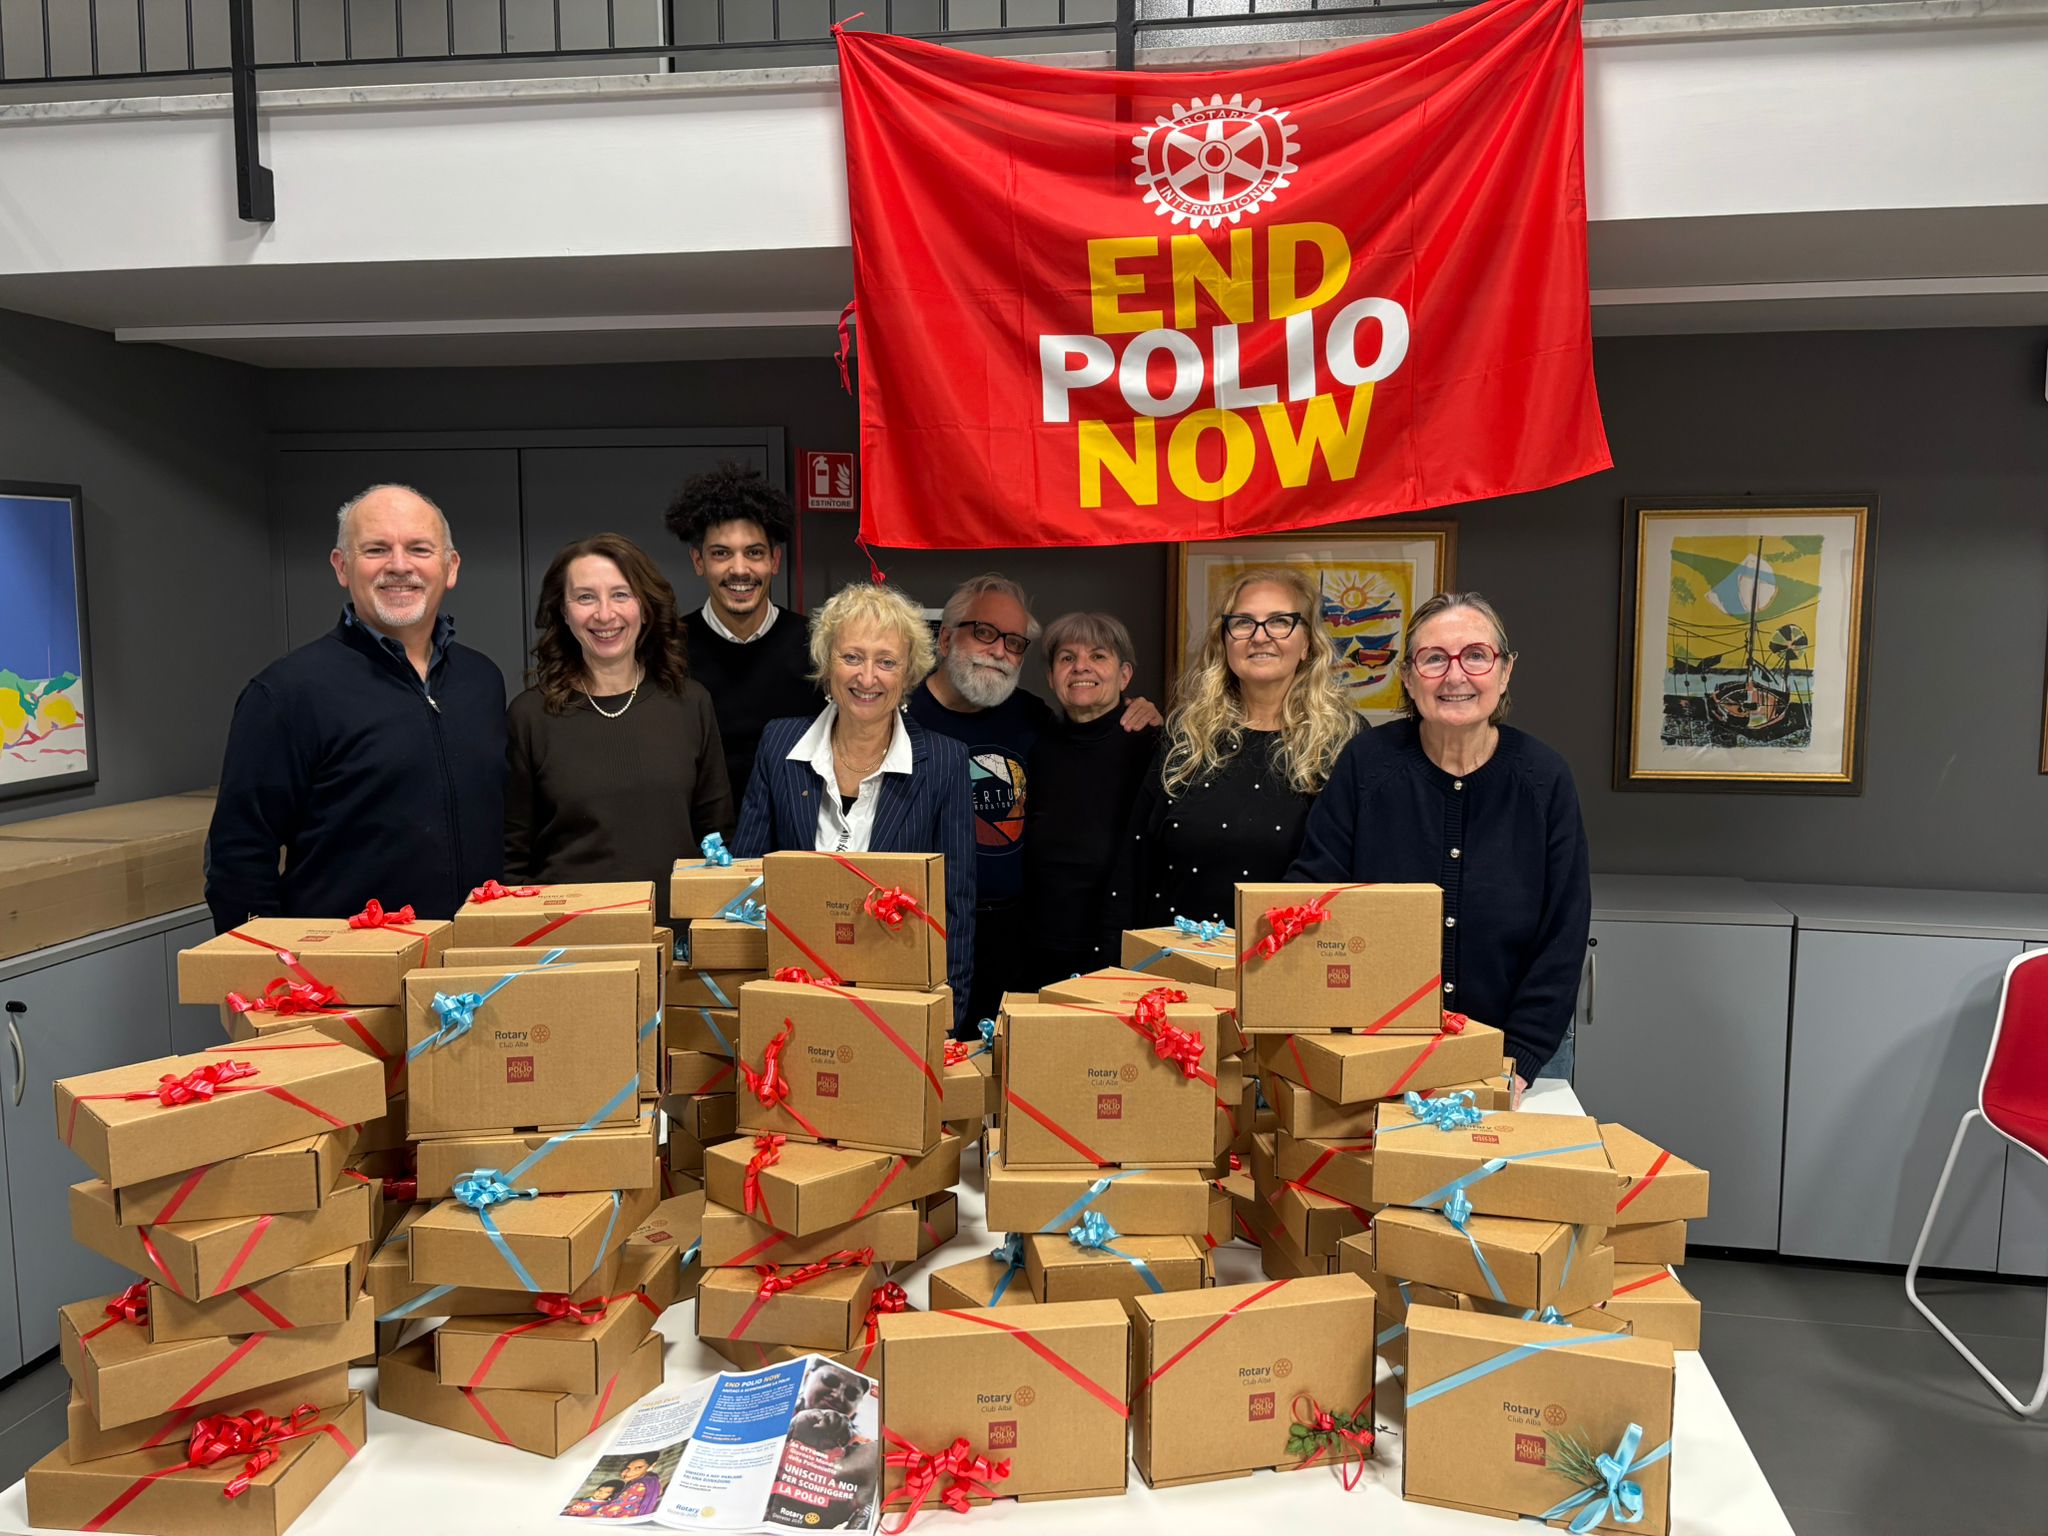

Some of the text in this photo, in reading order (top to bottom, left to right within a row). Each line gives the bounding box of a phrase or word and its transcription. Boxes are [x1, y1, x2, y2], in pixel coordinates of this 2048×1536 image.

[1182, 110, 1252, 126] ROTARY
[1159, 177, 1276, 216] INTERNATIONAL
[1087, 221, 1352, 334] END
[1039, 296, 1410, 423] POLIO
[1078, 381, 1375, 508] NOW
[810, 499, 852, 508] ESTINTORE
[825, 900, 850, 911] Rotary
[1316, 940, 1346, 951] Rotary
[495, 1030, 528, 1041] Rotary
[807, 1046, 835, 1058] Rotary
[1087, 1068, 1119, 1079] Rotary
[1238, 1366, 1271, 1377] Rotary
[741, 1378, 763, 1387] POLIO
[763, 1373, 782, 1382] NOW
[976, 1394, 1012, 1404] Rotary
[1251, 1401, 1274, 1410] POLIO
[1503, 1401, 1541, 1418] Rotary
[1507, 1414, 1541, 1426] Club Alba
[990, 1430, 1016, 1439] POLIO
[1516, 1443, 1545, 1455] POLIO
[1521, 1438, 1540, 1448] END
[784, 1463, 858, 1493] UNISCITI A NOI
[781, 1473, 855, 1500] PER SCONFIGGERE
[779, 1484, 826, 1505] LA POLIO
[676, 1503, 700, 1514] Rotary
[780, 1507, 805, 1520] Rotary
